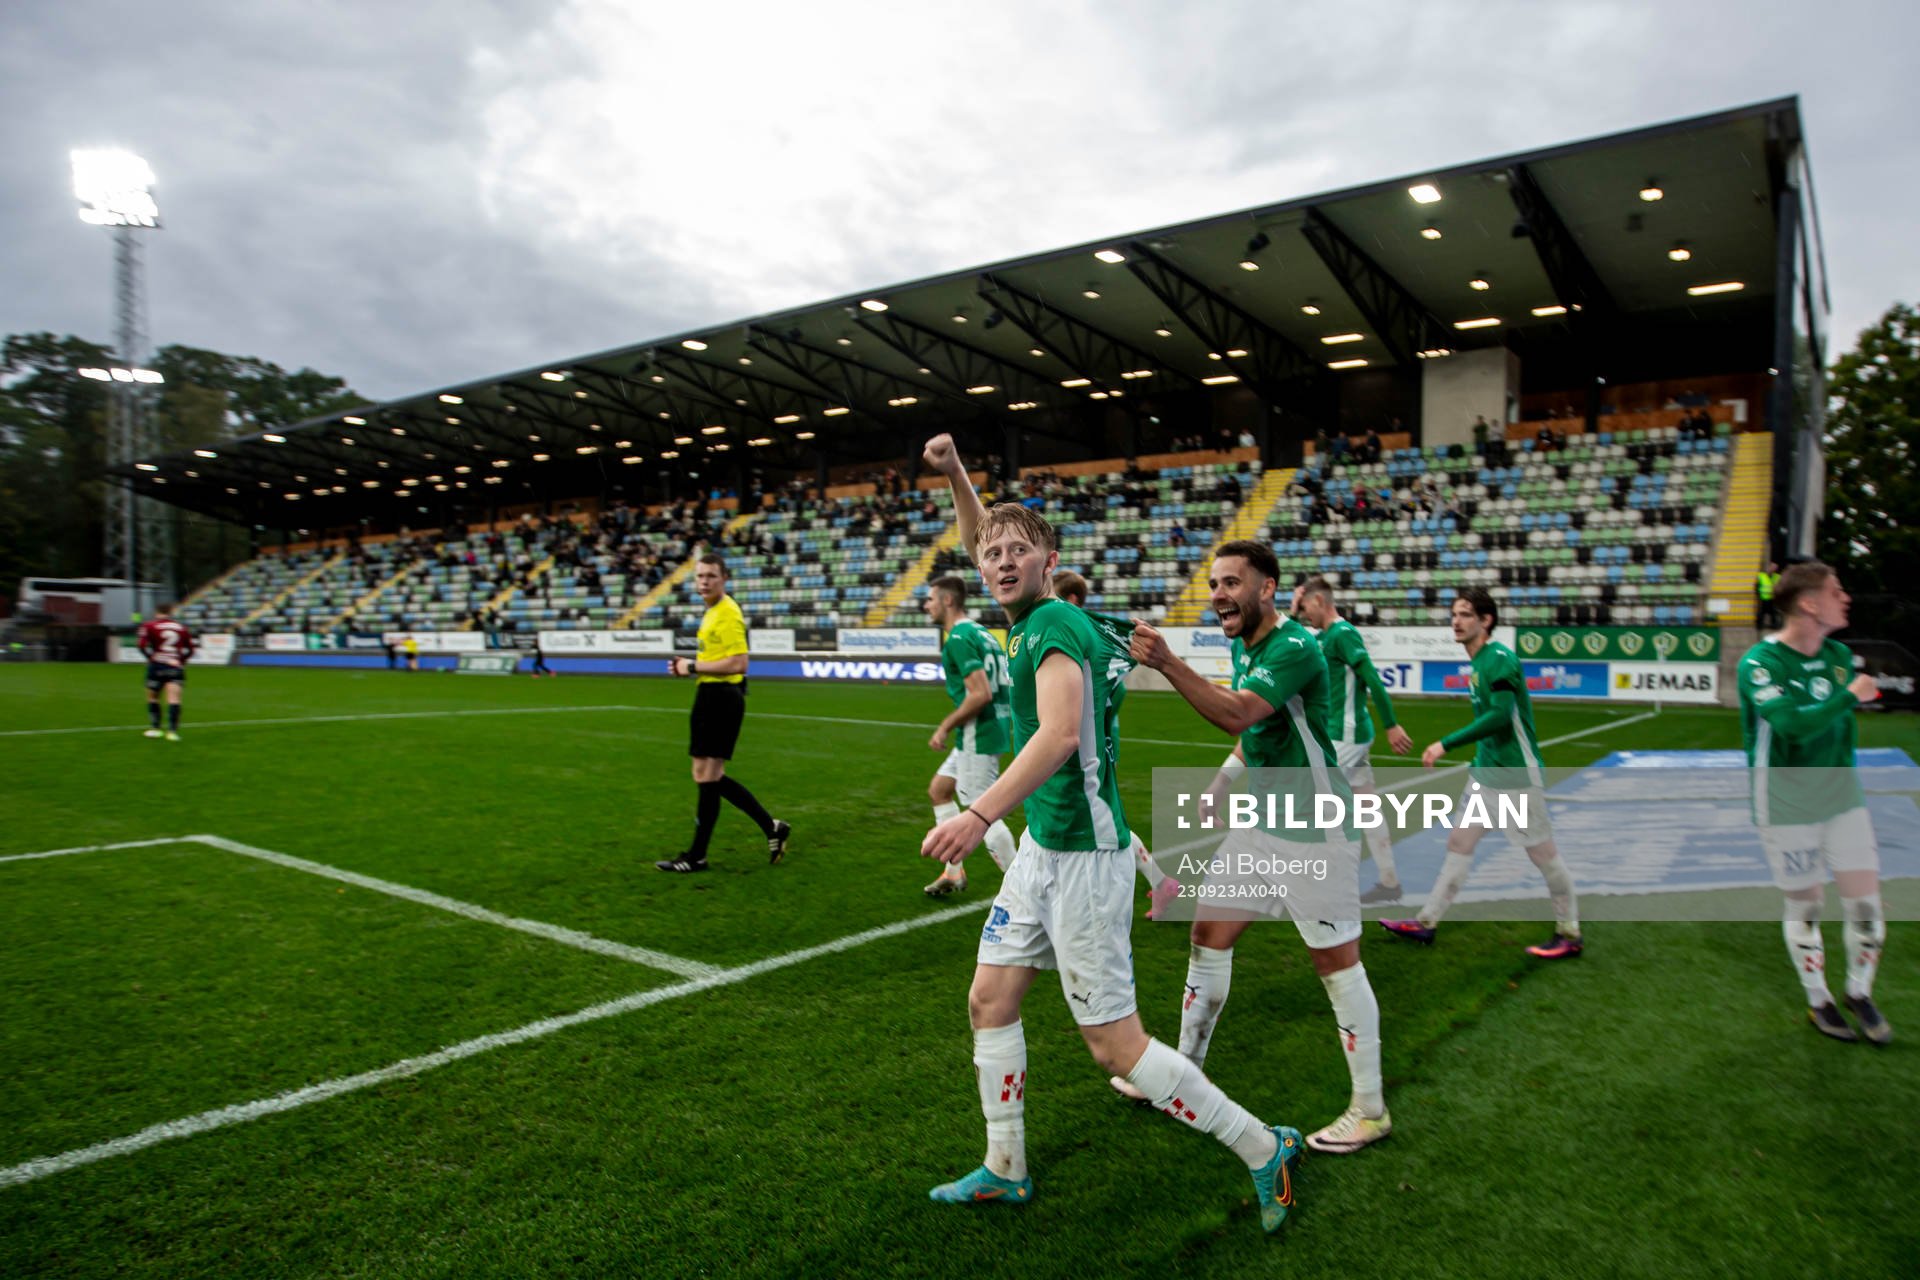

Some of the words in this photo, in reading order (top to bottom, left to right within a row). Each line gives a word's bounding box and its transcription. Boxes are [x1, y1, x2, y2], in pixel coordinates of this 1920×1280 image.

[160, 629, 180, 652] 2
[1376, 664, 1412, 688] ST
[1632, 674, 1712, 691] JEMAB
